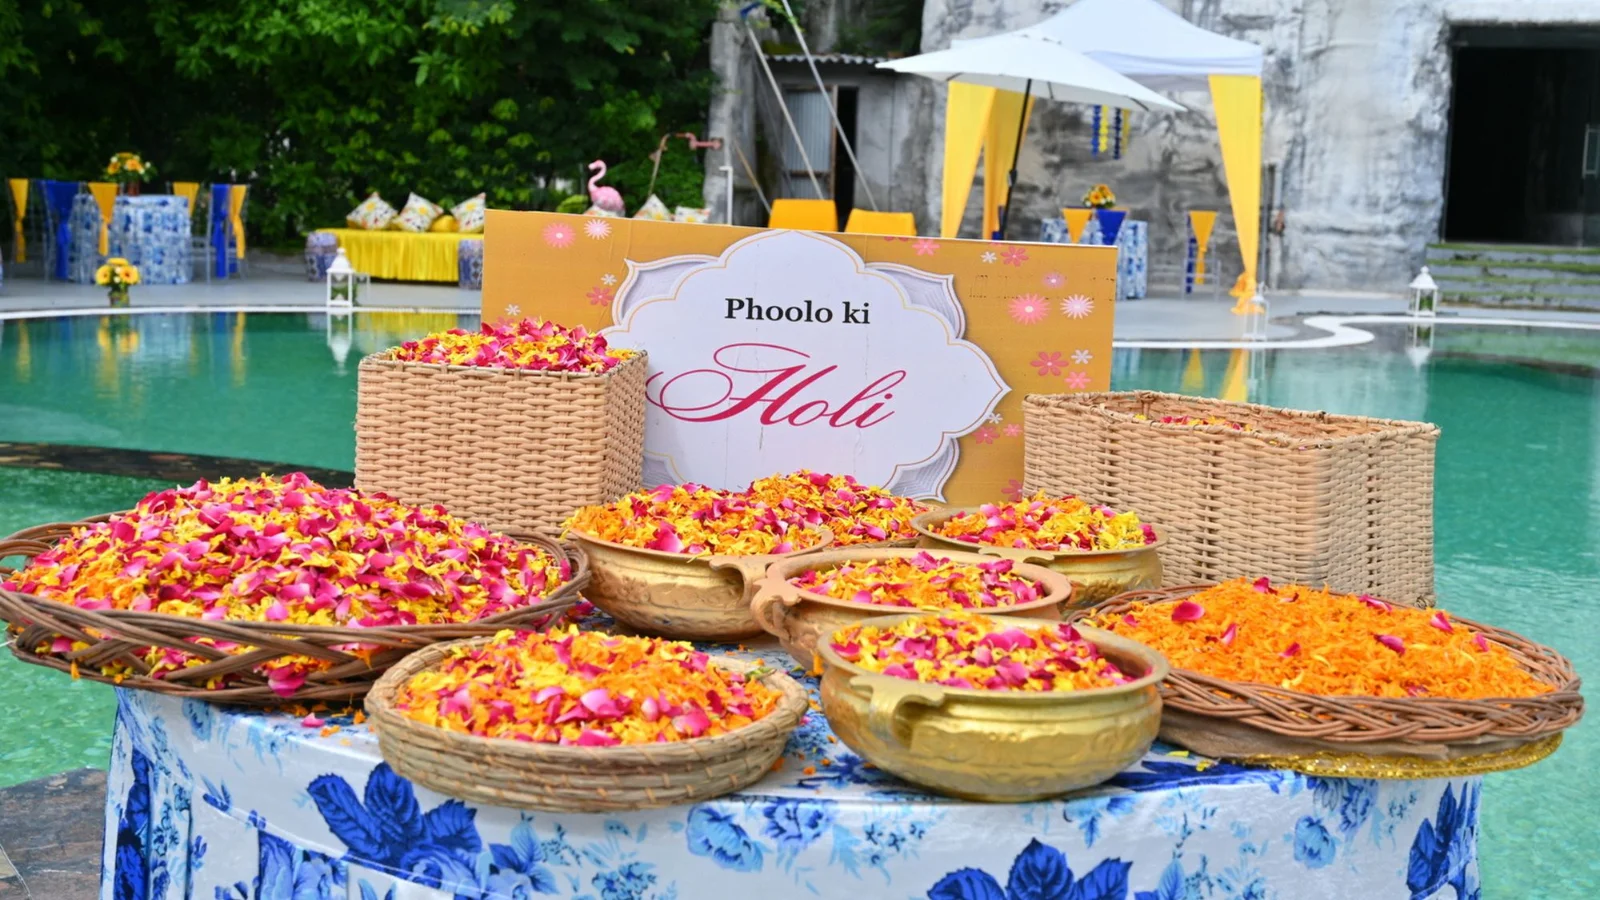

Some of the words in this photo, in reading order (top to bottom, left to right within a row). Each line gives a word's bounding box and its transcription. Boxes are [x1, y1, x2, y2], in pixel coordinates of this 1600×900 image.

[724, 297, 833, 324] Phoolo
[841, 301, 871, 325] ki
[645, 342, 907, 429] Holi
